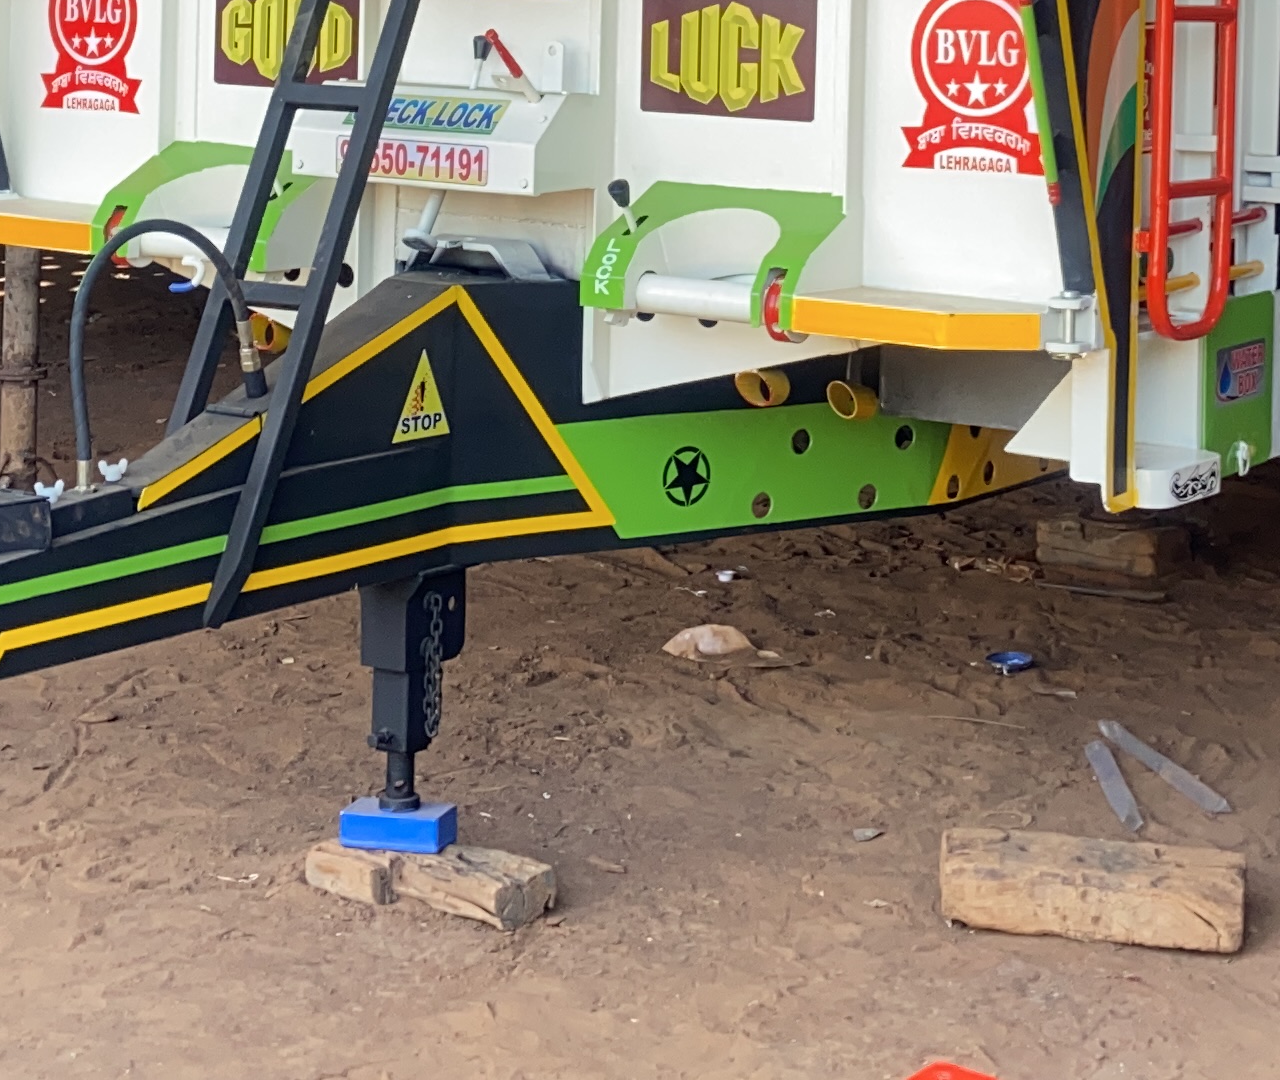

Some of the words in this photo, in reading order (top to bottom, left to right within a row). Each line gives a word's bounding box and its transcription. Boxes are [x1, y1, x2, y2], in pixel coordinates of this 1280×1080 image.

[650, 1, 806, 112] LUCK
[934, 28, 1020, 67] BVLG
[66, 97, 116, 112] LEHRAGAGA
[352, 97, 437, 125] ECK
[431, 101, 502, 130] LOCK
[939, 154, 1012, 173] LEHRAGAGA
[594, 238, 621, 295] LOCK
[401, 412, 442, 434] STOP
